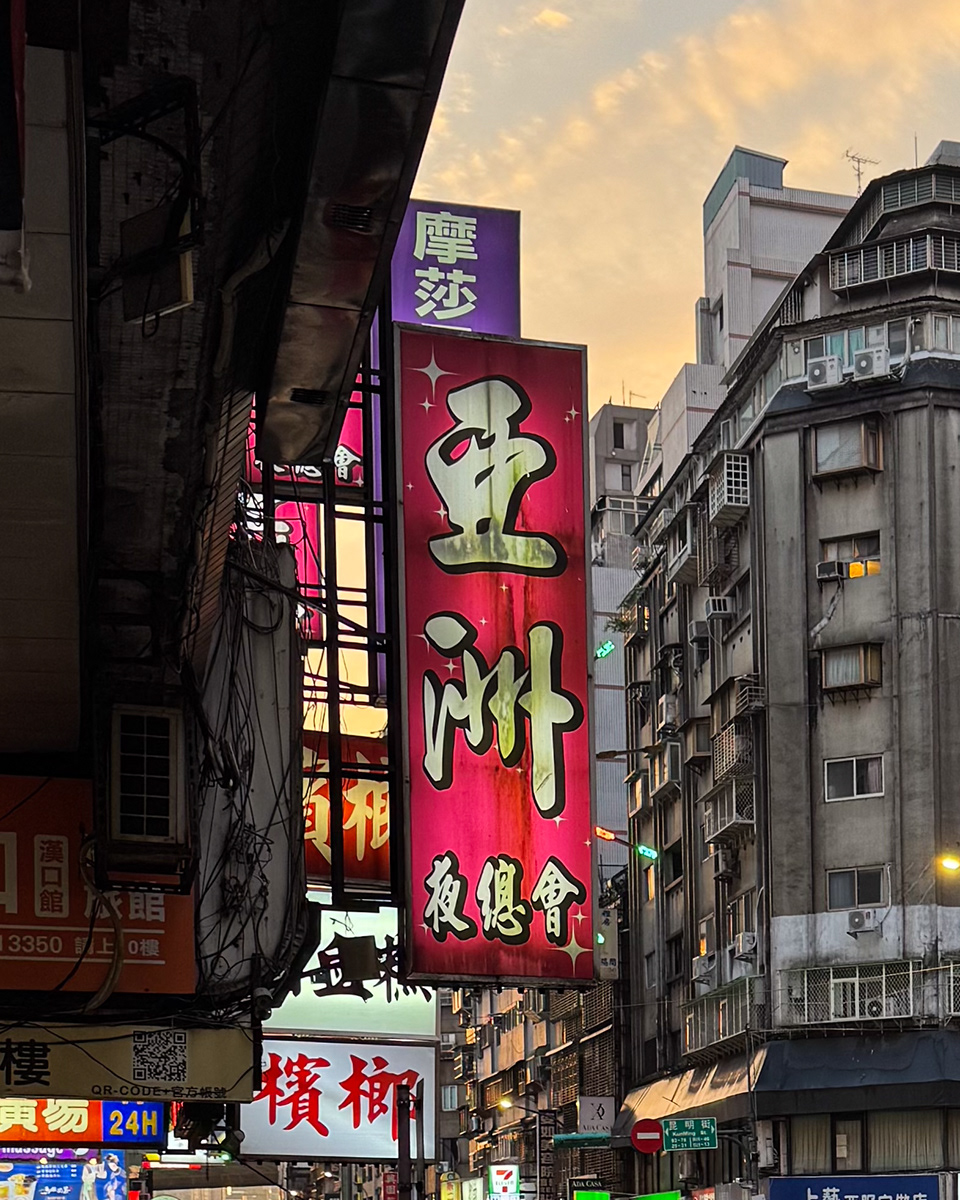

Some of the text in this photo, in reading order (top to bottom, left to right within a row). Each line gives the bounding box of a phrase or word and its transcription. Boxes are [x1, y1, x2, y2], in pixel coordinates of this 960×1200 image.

[412, 210, 478, 320] 摩莎
[424, 377, 576, 812] 亞洲
[39, 840, 64, 914] 漢口館
[425, 852, 580, 935] 夜總會
[0, 1038, 51, 1087] 樓
[253, 1052, 420, 1138] 檳榔
[109, 1110, 158, 1136] 24H
[669, 1120, 711, 1131] 昆明街
